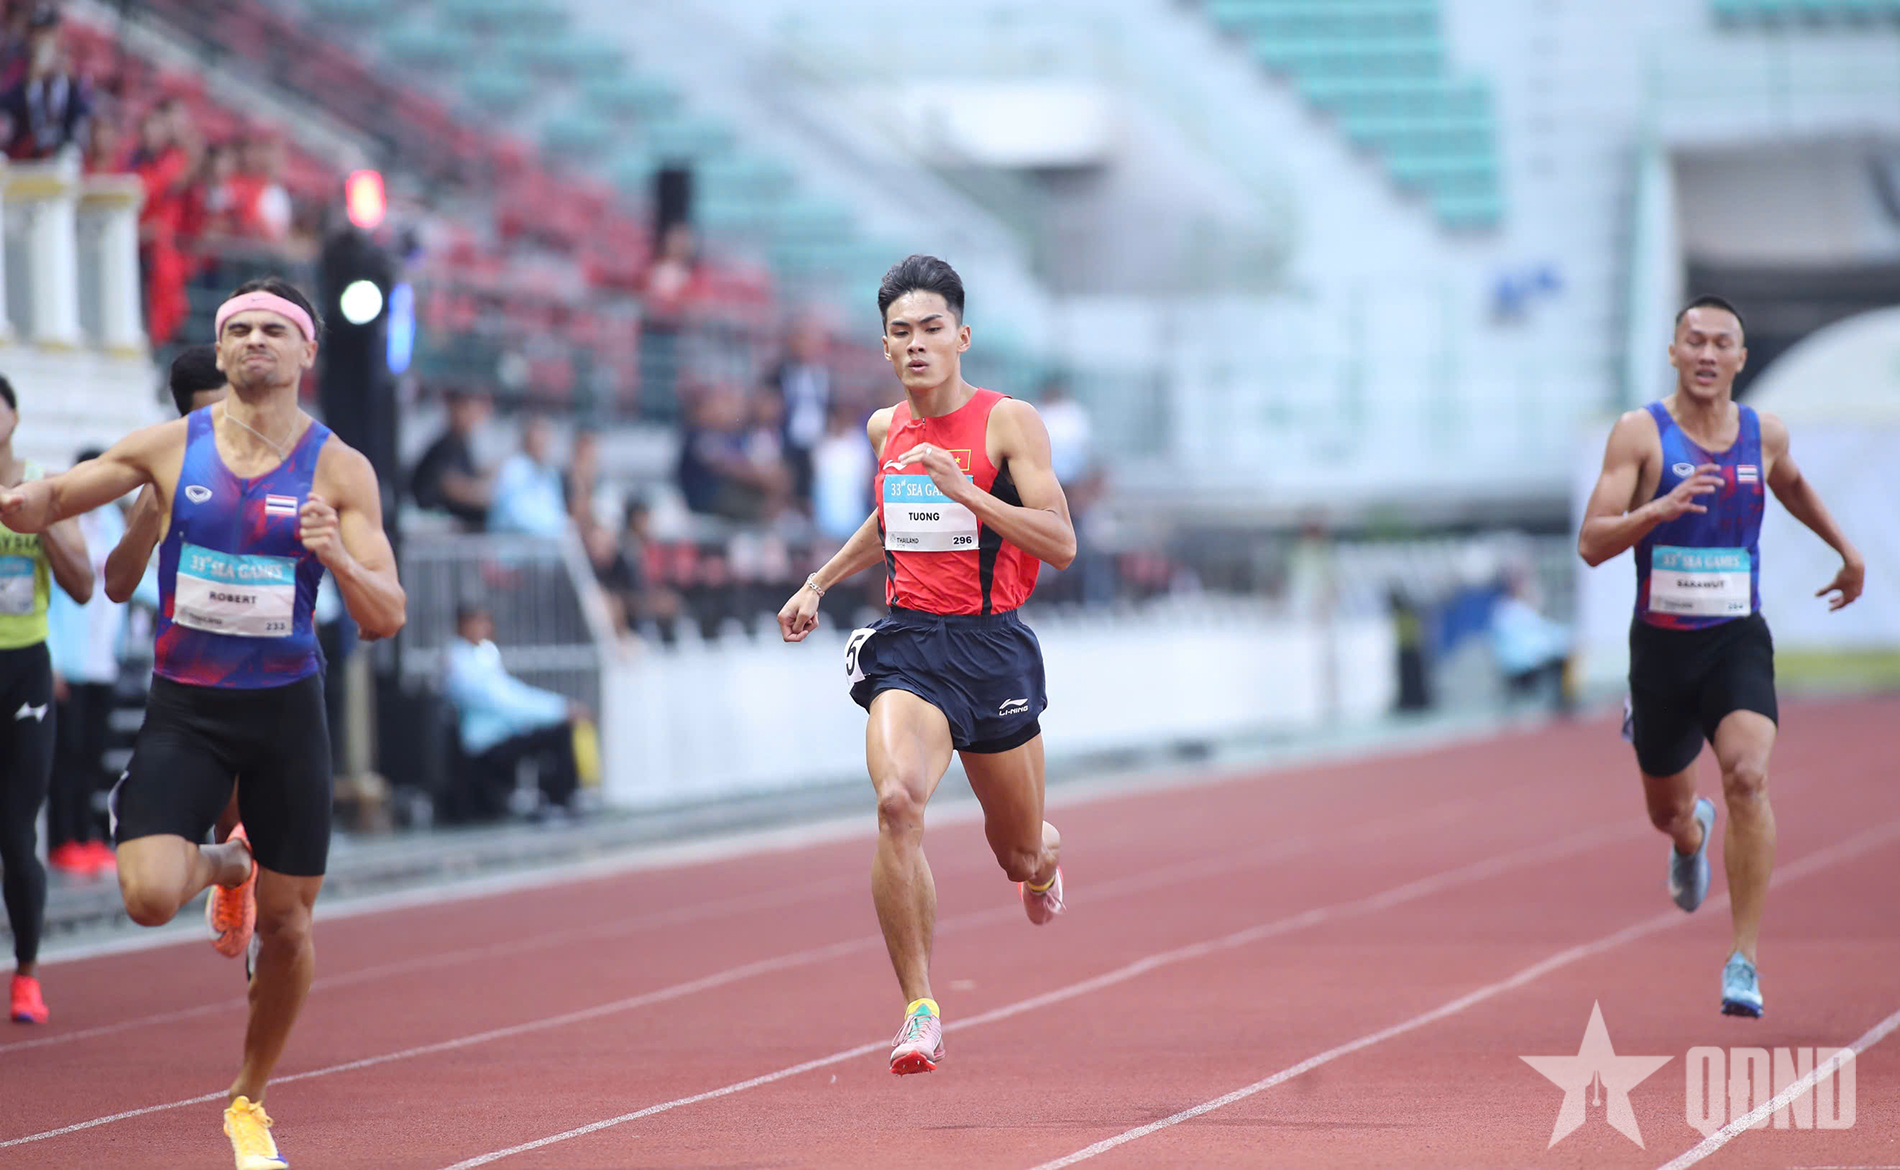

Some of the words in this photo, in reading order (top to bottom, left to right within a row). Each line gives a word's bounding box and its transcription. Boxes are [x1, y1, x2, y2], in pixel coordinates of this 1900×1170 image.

[907, 483, 923, 496] SEA
[908, 512, 940, 521] TUONG
[953, 536, 972, 545] 296
[209, 591, 257, 605] ROBERT
[846, 634, 865, 677] 5
[999, 705, 1029, 716] LI-NING
